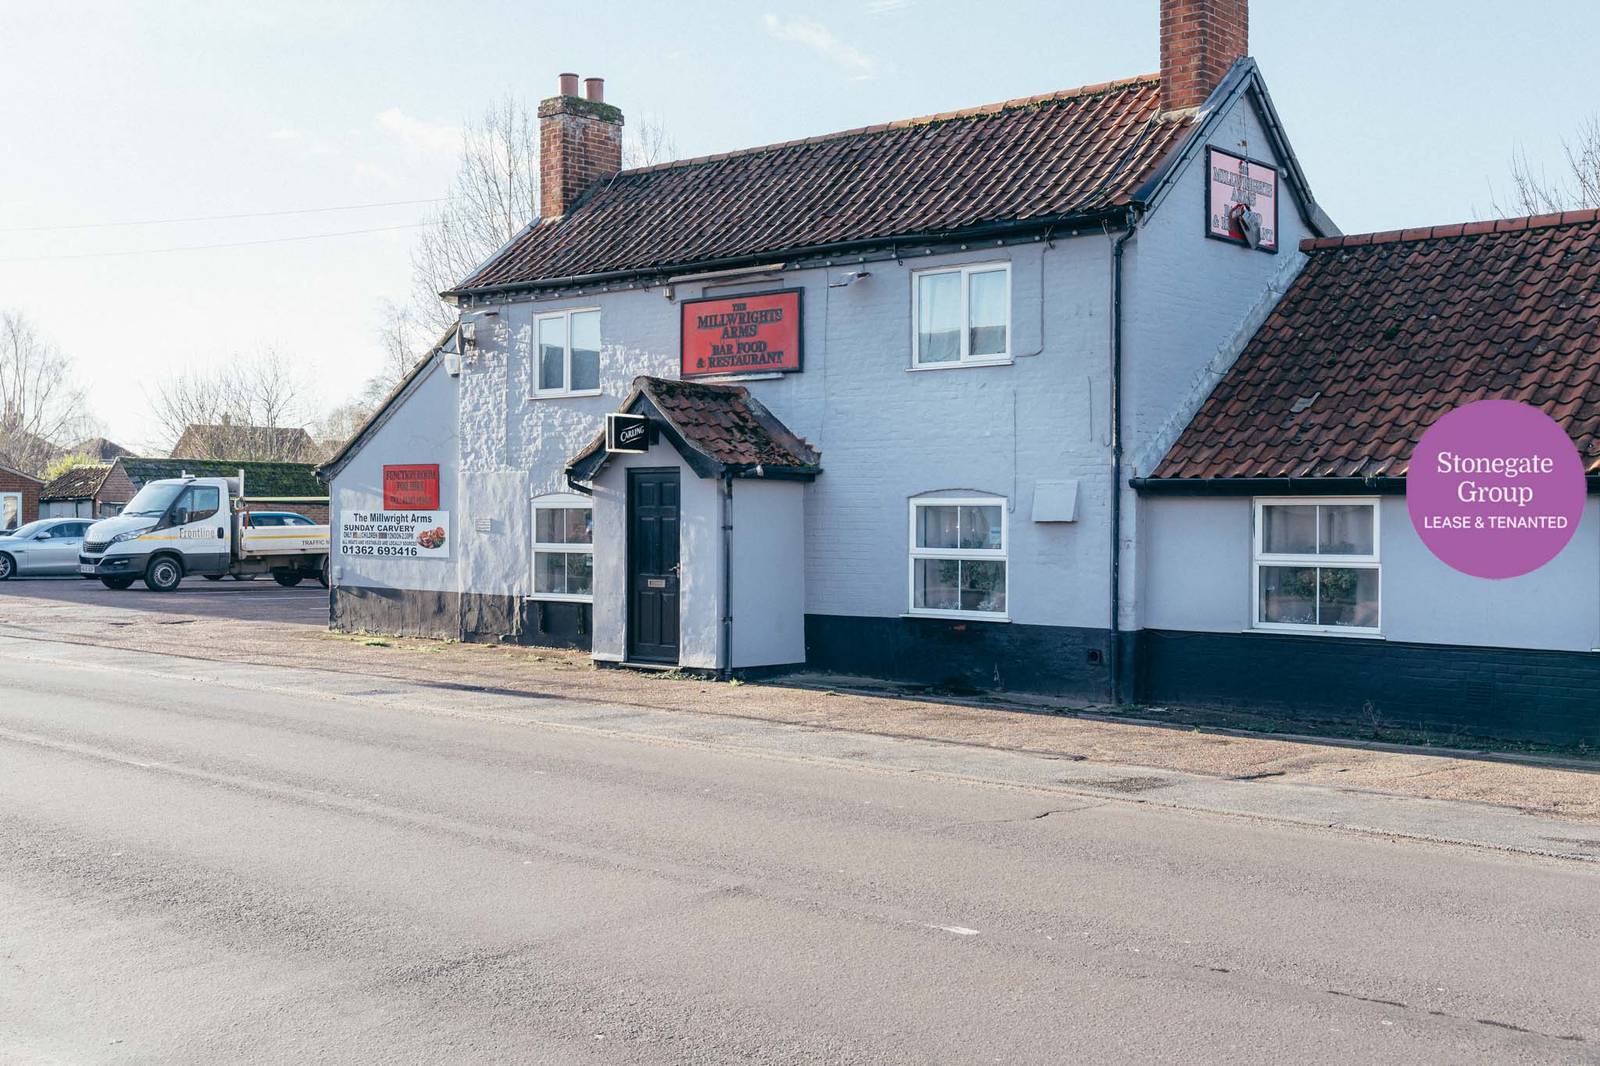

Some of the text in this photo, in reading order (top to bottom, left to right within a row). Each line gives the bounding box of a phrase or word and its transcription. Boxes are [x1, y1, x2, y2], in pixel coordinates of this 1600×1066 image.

[732, 303, 747, 311] THE
[697, 309, 783, 329] MILLWRIGHTS
[722, 325, 757, 339] ARMS
[711, 341, 767, 356] BAR FOOD
[696, 351, 784, 369] & RESTAURANT
[620, 425, 645, 442] CARLING
[353, 513, 432, 525] The Millwright Arms
[179, 527, 215, 539] Frontline
[342, 546, 418, 556] 01362 693416
